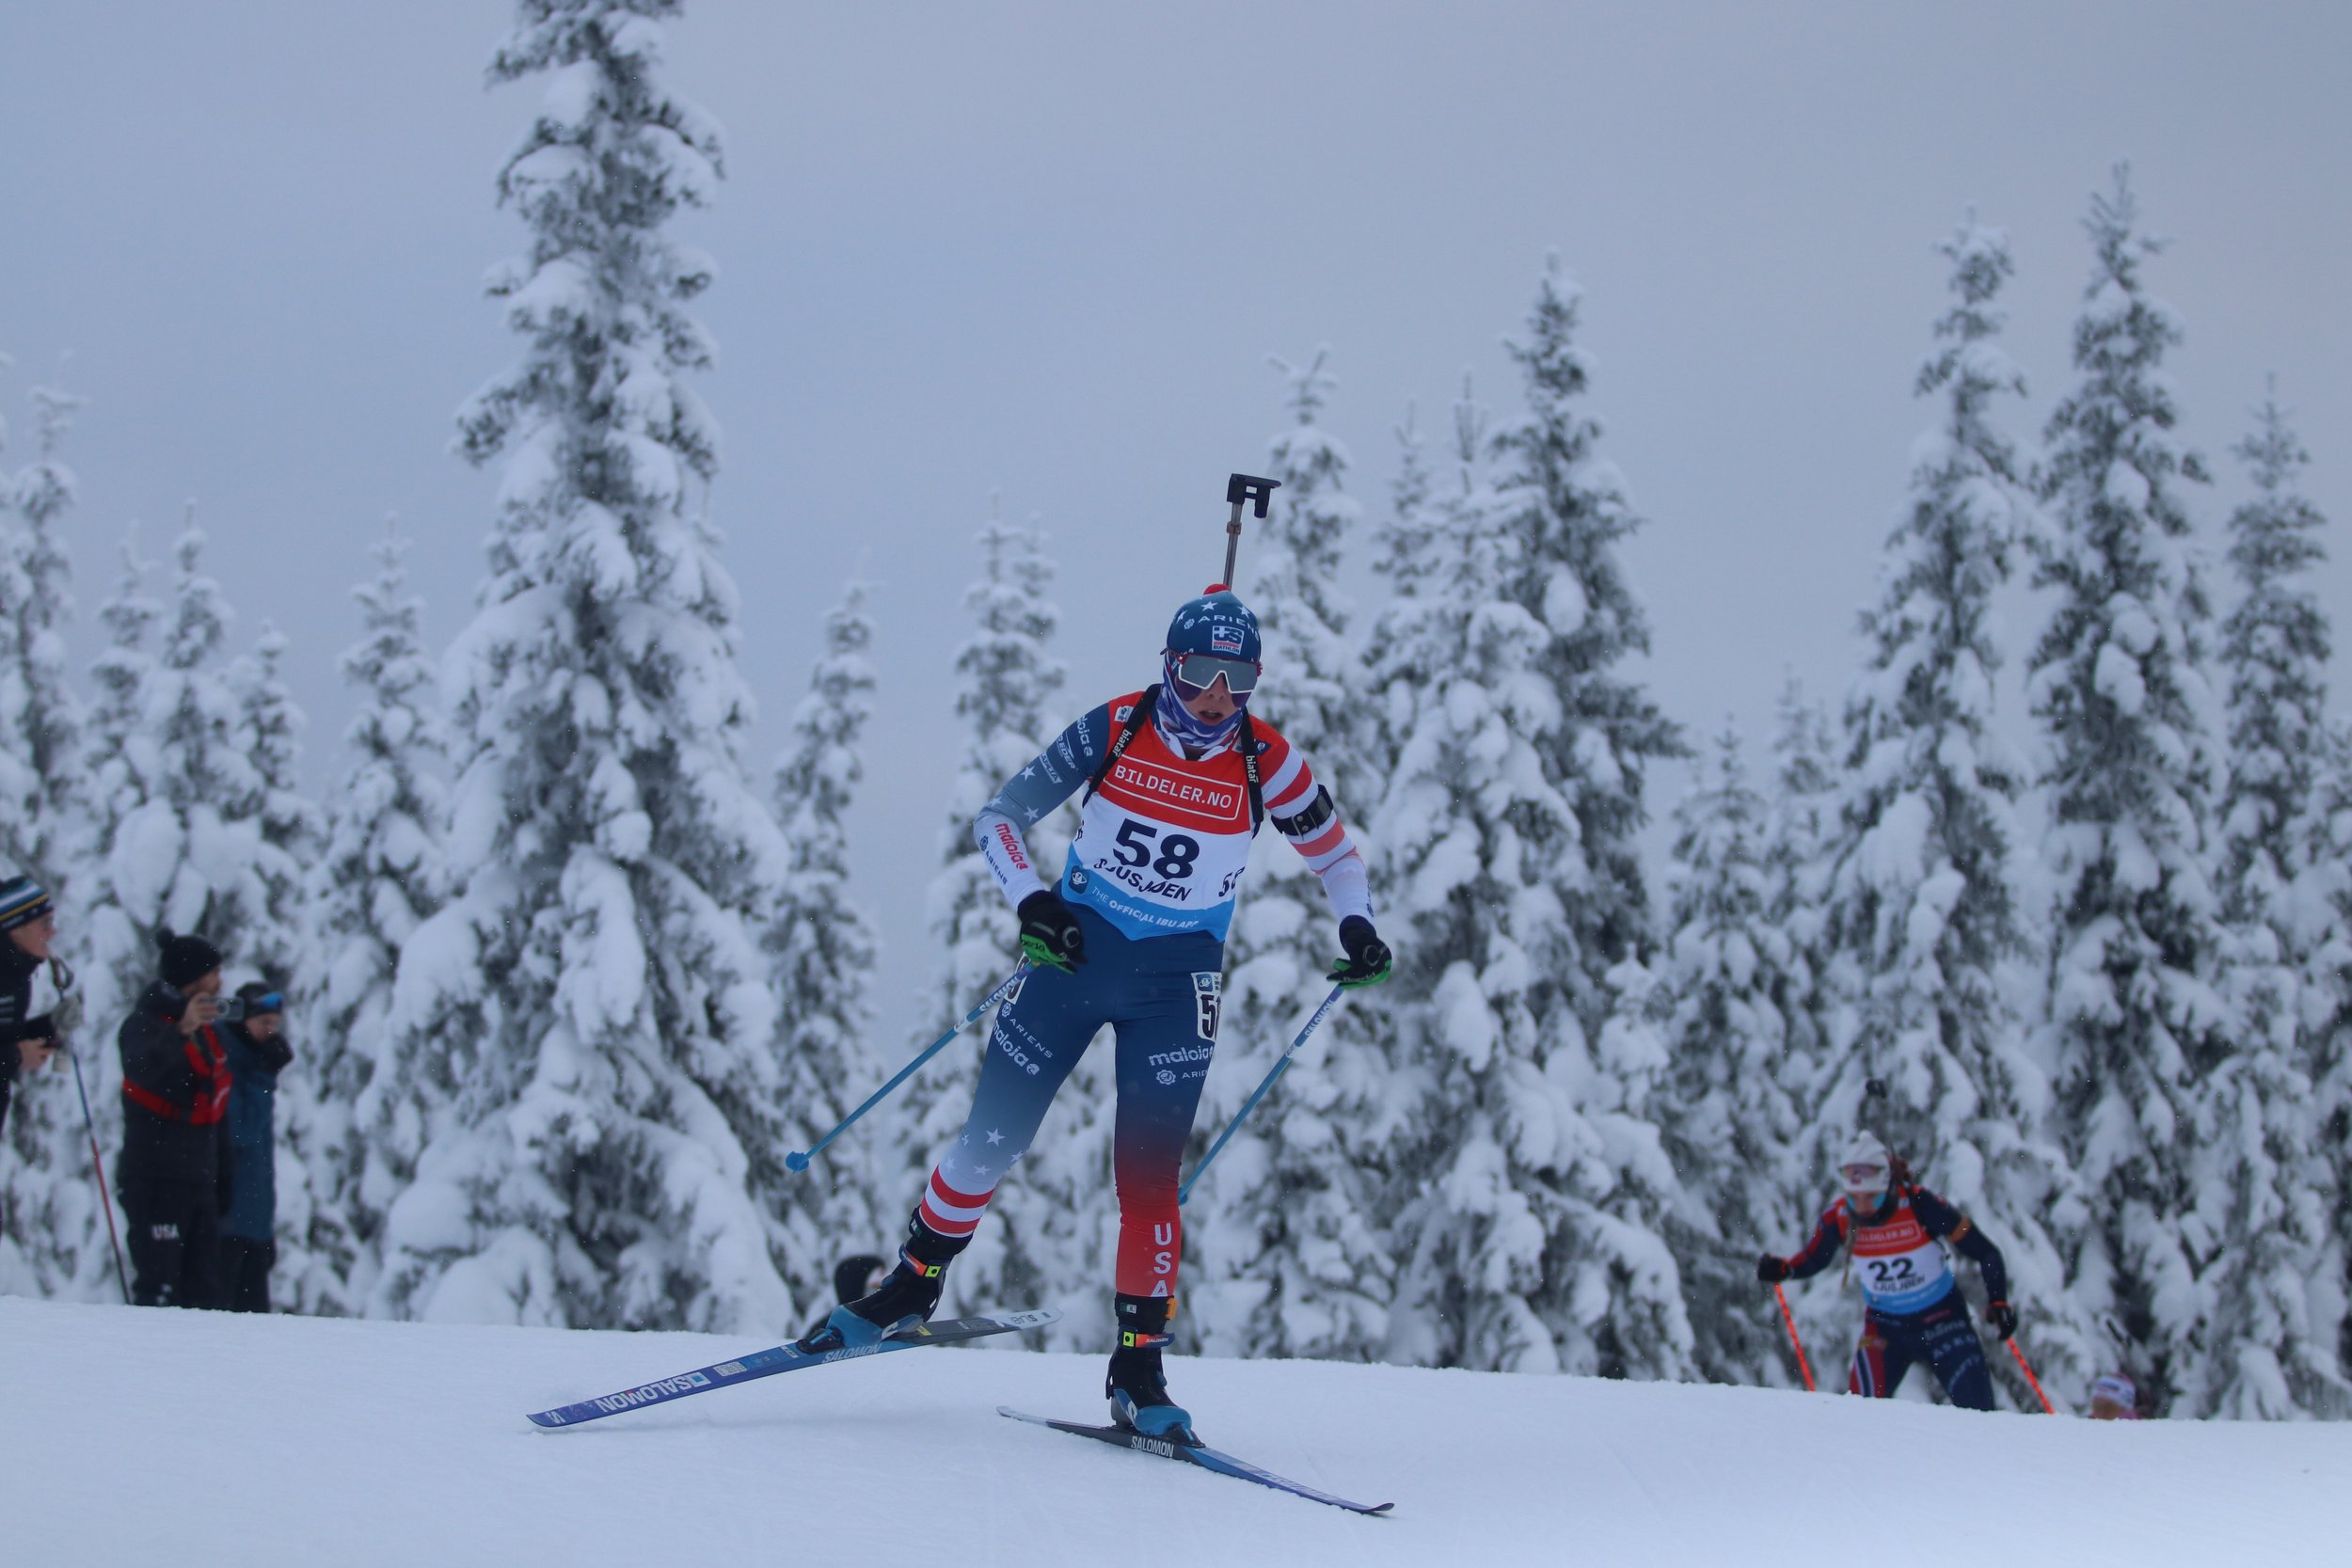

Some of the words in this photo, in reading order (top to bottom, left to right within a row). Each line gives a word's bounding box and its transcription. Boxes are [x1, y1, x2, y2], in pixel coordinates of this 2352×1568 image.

[1198, 614, 1260, 641] ARIENS
[1213, 644, 1240, 653] BIATHLON
[1114, 765, 1232, 809] BILDELER.NO
[986, 850, 1008, 885] ARIENS
[1113, 817, 1200, 880] 58
[1093, 858, 1192, 901] SUSJØEN
[1092, 886, 1110, 904] THE
[1110, 899, 1154, 923] OFFICIAL
[1155, 917, 1177, 927] IBU
[1200, 993, 1221, 1039] 5
[993, 1020, 1029, 1067] maloja
[1009, 1018, 1054, 1059] ARIENS
[1148, 1045, 1209, 1067] maloja
[151, 1224, 179, 1240] USA
[1150, 1223, 1172, 1297] USA
[1867, 1257, 1915, 1282] 22
[821, 1344, 882, 1365] SALOMON
[595, 1374, 694, 1413] SALOMON
[1130, 1435, 1175, 1458] SALOMON
